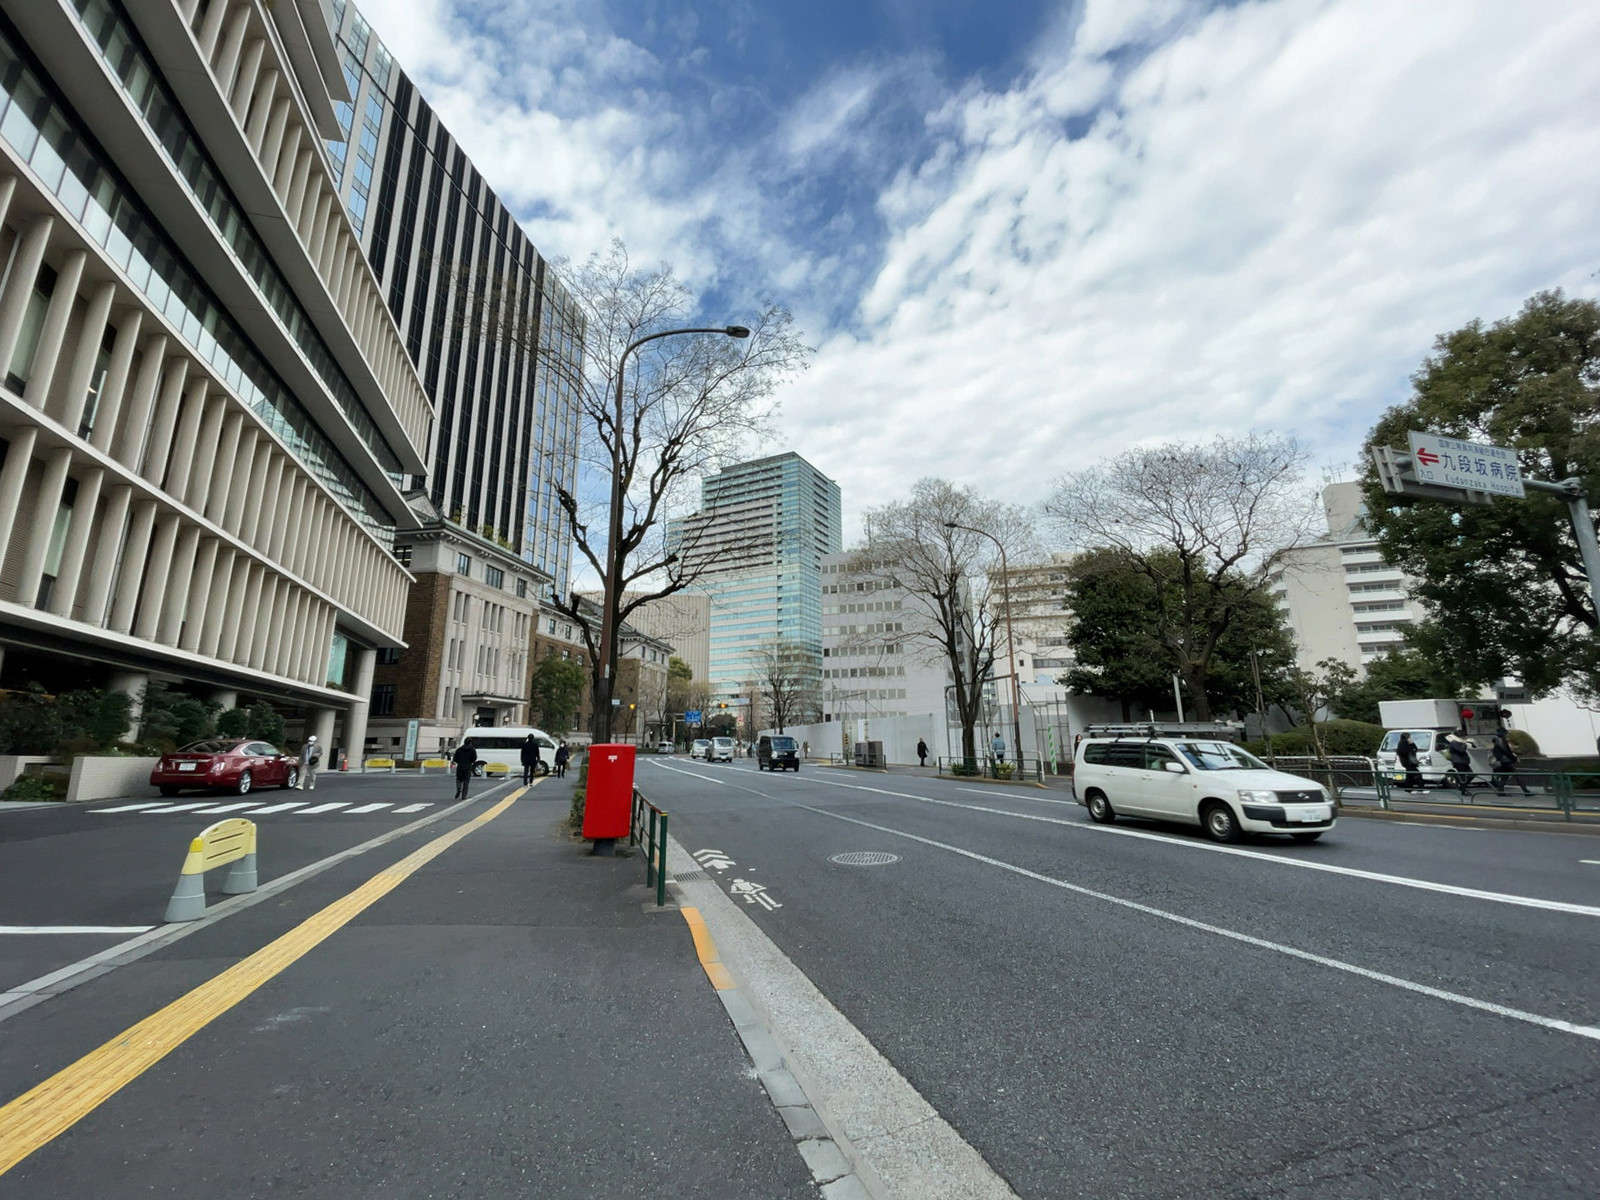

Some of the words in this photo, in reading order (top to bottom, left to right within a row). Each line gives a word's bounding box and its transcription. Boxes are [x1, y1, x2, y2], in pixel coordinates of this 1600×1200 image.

[1441, 452, 1518, 482] 九段坂病院
[1445, 474, 1487, 489] Kudanzaka
[1491, 481, 1522, 494] Hospital
